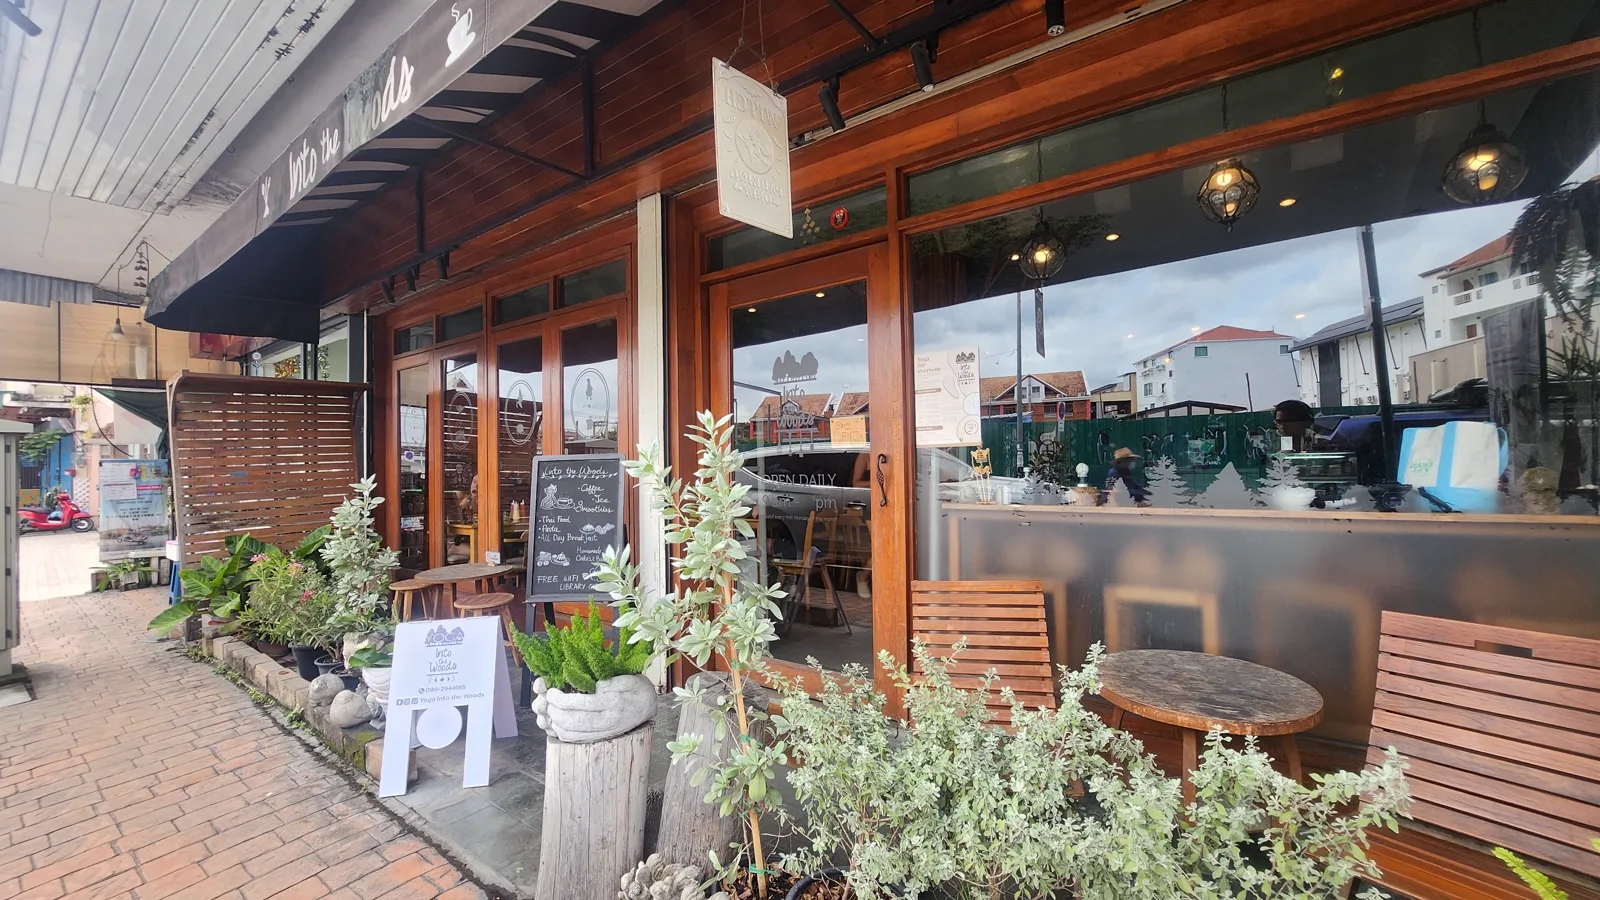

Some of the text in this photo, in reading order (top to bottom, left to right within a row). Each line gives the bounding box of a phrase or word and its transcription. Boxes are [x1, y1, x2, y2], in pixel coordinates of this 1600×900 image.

[289, 56, 414, 200] Into the ods
[783, 384, 806, 402] Into
[566, 467, 578, 475] the
[579, 466, 608, 475] Woods
[799, 473, 837, 487] DAILY
[581, 483, 605, 494] Coffee
[594, 494, 610, 503] Tea
[541, 515, 571, 523] Thai Food
[542, 524, 561, 533] Pasta
[553, 533, 565, 544] Day
[537, 574, 579, 584] FREE WIFI
[560, 582, 586, 590] LIBRARY
[426, 632, 465, 643] YOGA
[435, 648, 452, 658] Into
[429, 661, 458, 672] Woods
